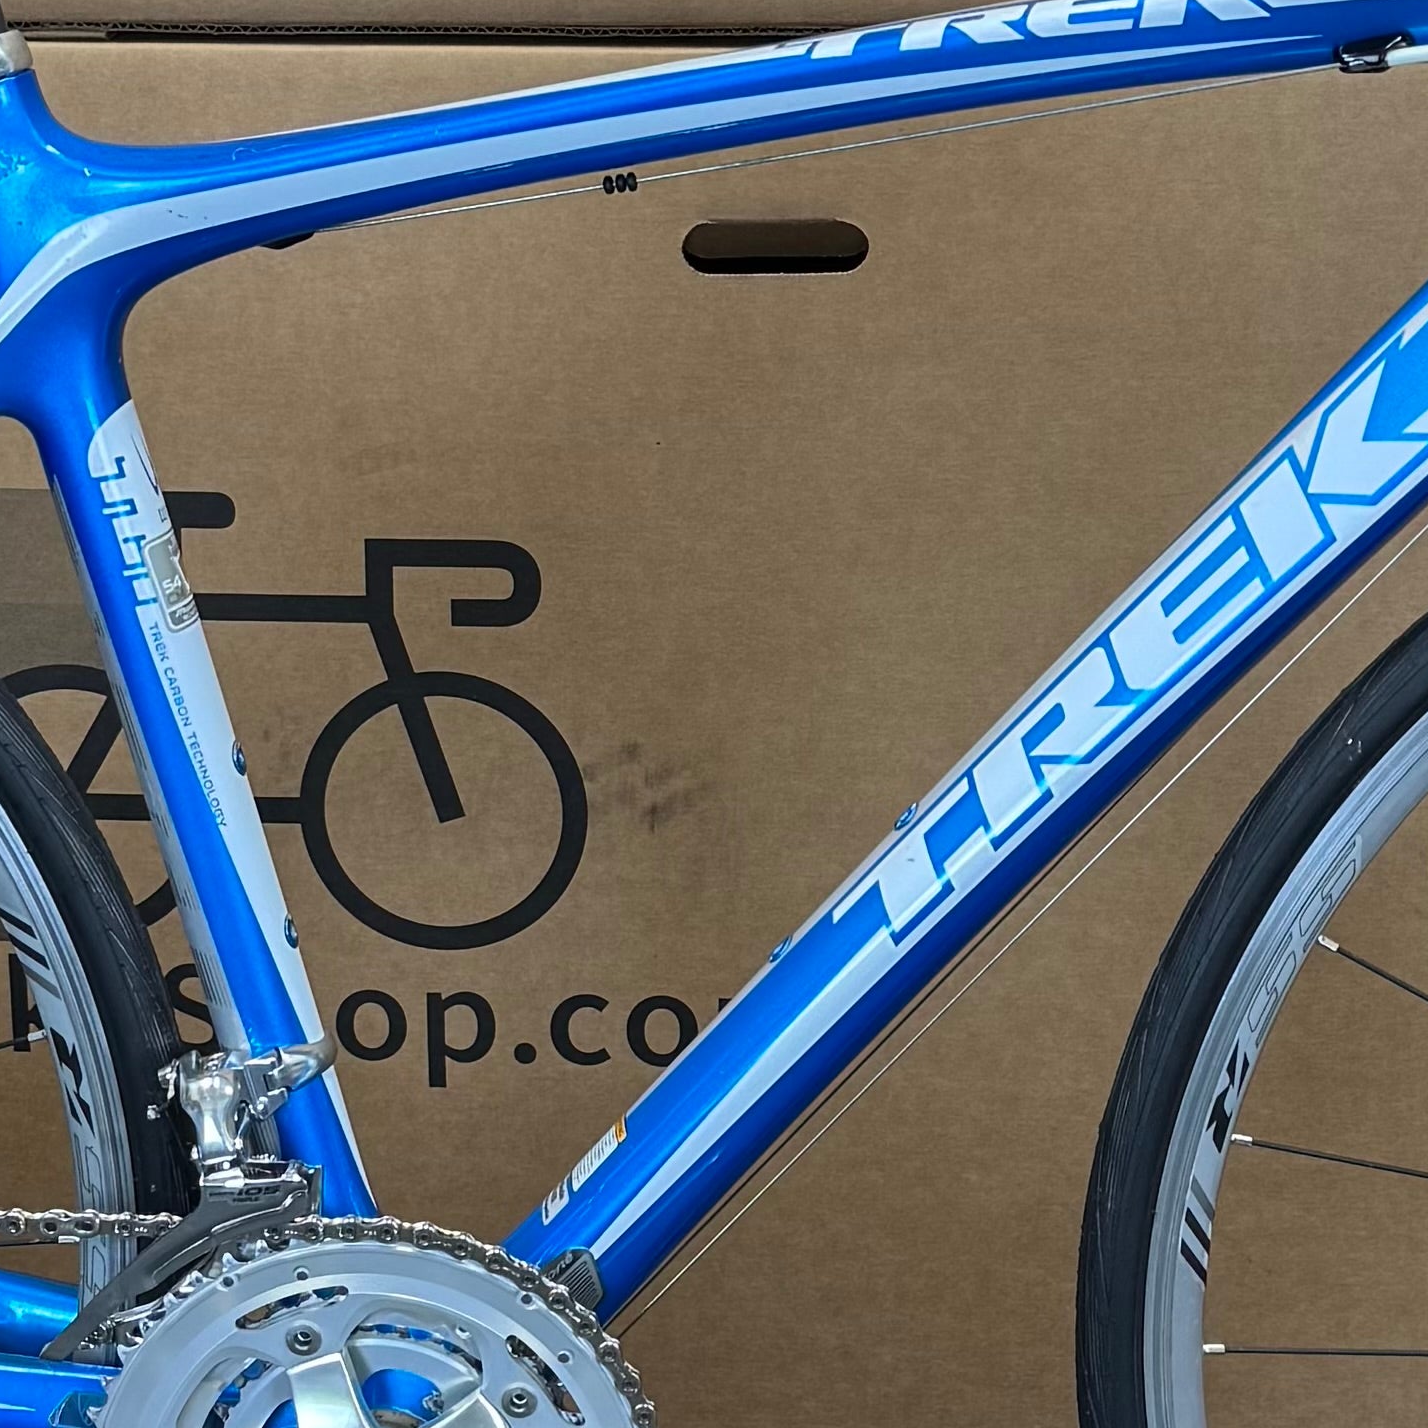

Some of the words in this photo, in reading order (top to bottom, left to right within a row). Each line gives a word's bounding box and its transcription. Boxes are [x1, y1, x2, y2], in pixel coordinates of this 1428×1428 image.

[149, 622, 169, 662] TREK
[164, 667, 192, 727] CARBON
[187, 732, 227, 828] TECHNOLOGY
